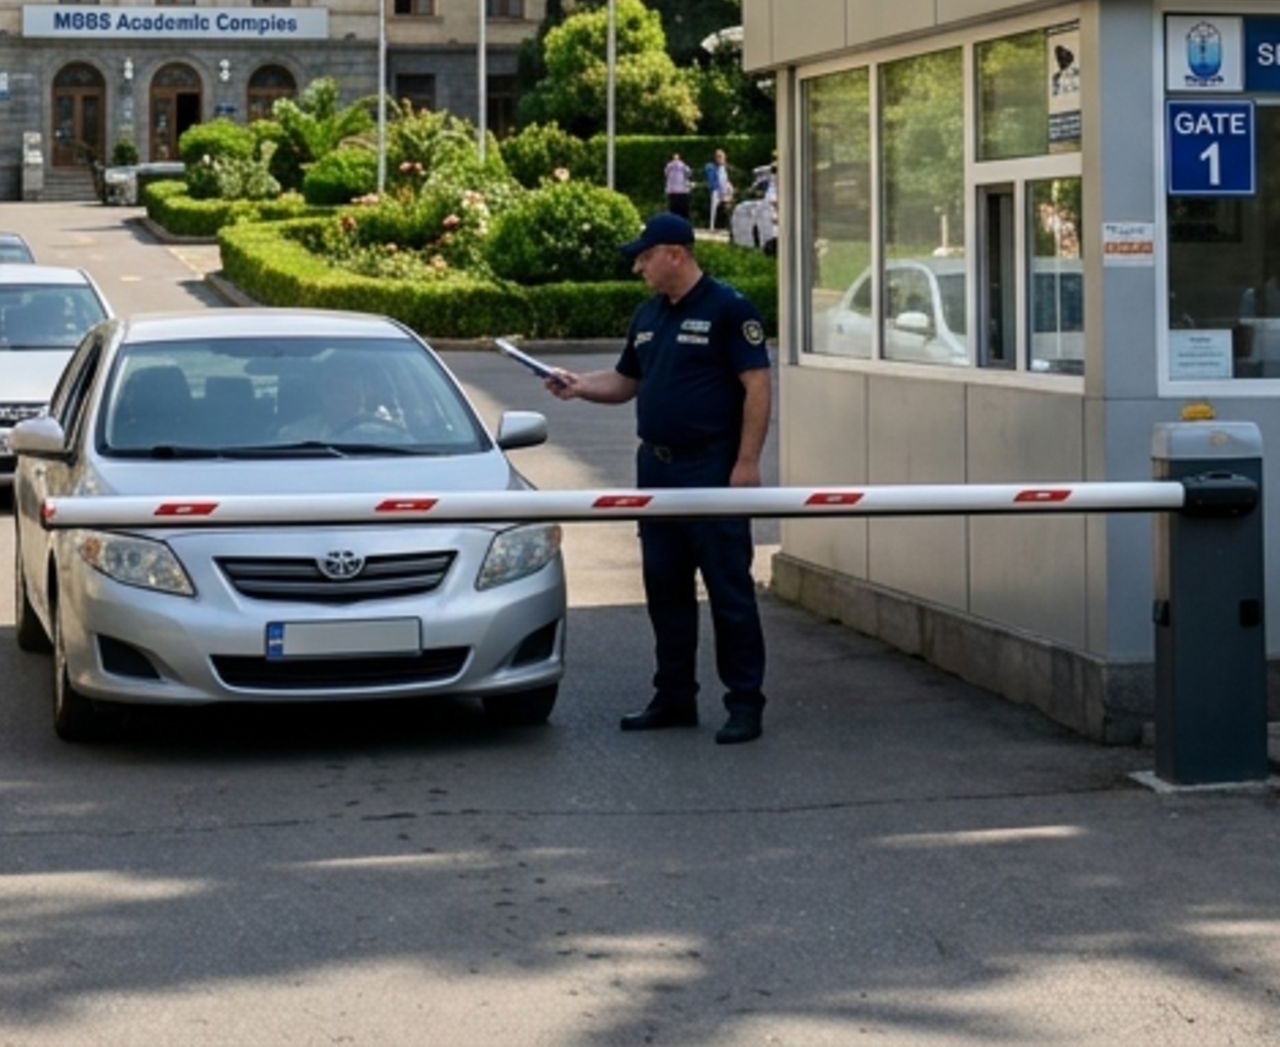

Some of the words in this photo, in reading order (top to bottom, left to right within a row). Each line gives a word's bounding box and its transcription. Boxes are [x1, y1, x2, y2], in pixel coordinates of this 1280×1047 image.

[53, 11, 111, 31] MBBS
[115, 13, 210, 32] Academic
[1174, 112, 1246, 135] GATE
[1199, 141, 1220, 186] 1
